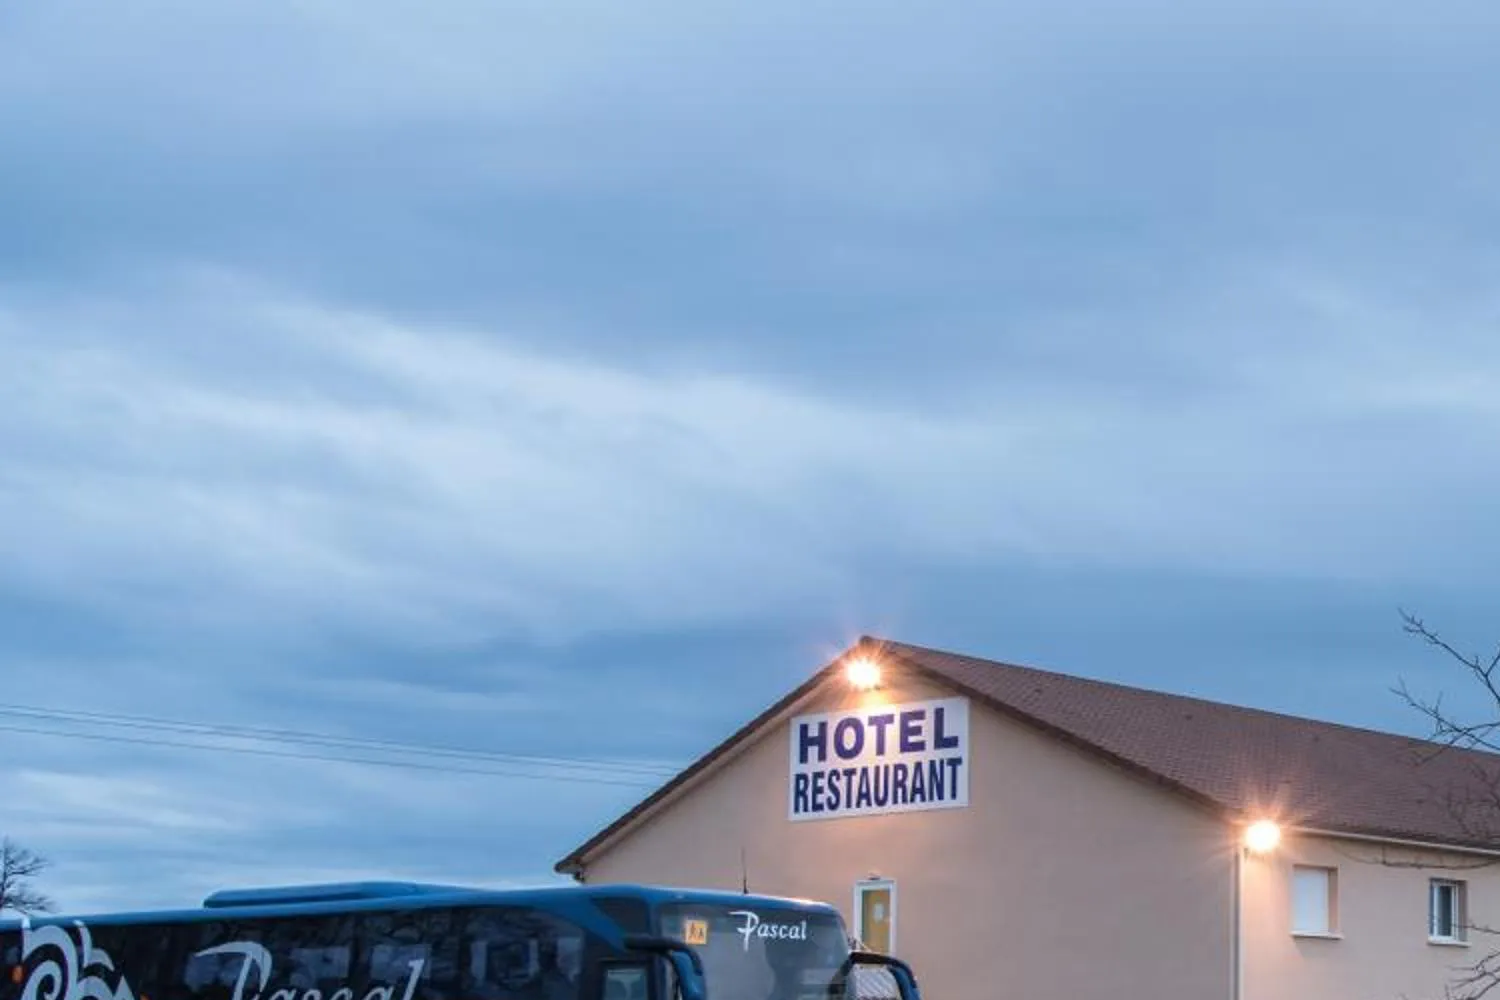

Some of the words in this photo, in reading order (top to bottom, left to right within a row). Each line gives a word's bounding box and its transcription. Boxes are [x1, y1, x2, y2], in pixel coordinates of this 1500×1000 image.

[799, 706, 960, 765] HOTEL
[792, 756, 963, 814] RESTAURANT
[728, 910, 808, 952] Pascal
